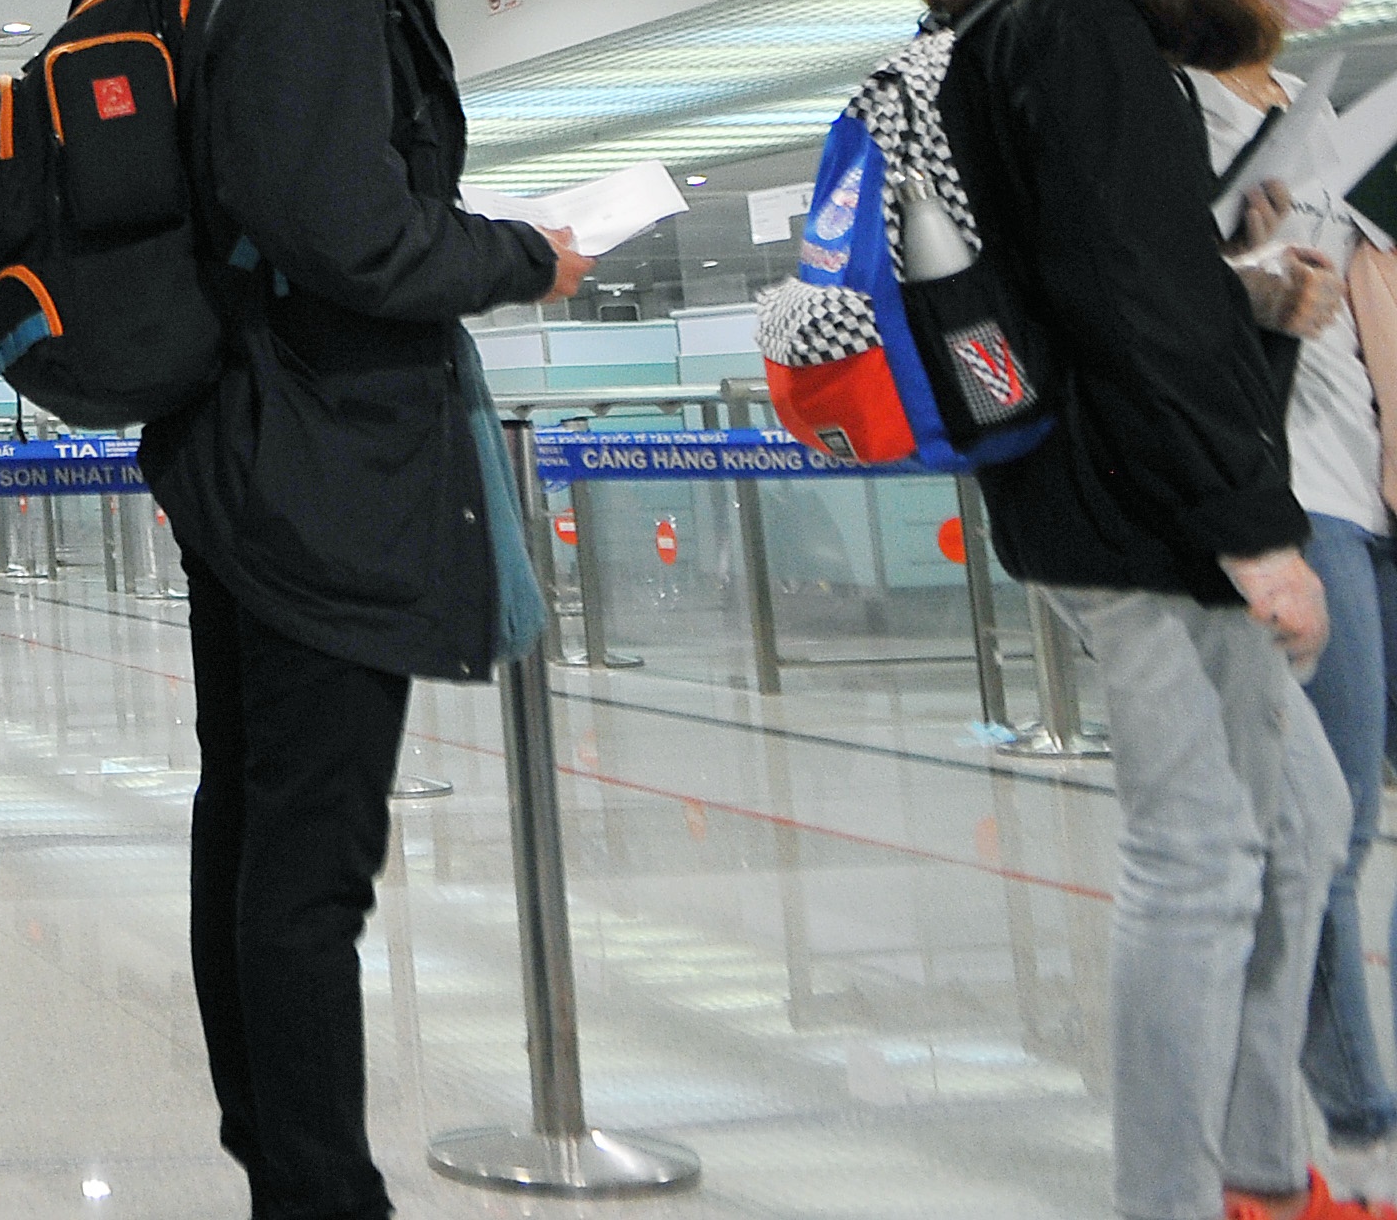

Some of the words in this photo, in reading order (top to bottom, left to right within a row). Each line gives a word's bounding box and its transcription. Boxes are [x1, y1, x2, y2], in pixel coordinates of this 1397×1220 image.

[54, 444, 98, 458] TIA
[722, 446, 803, 470] KHÔNG
[0, 468, 48, 486] SON
[55, 466, 114, 485] NHAT
